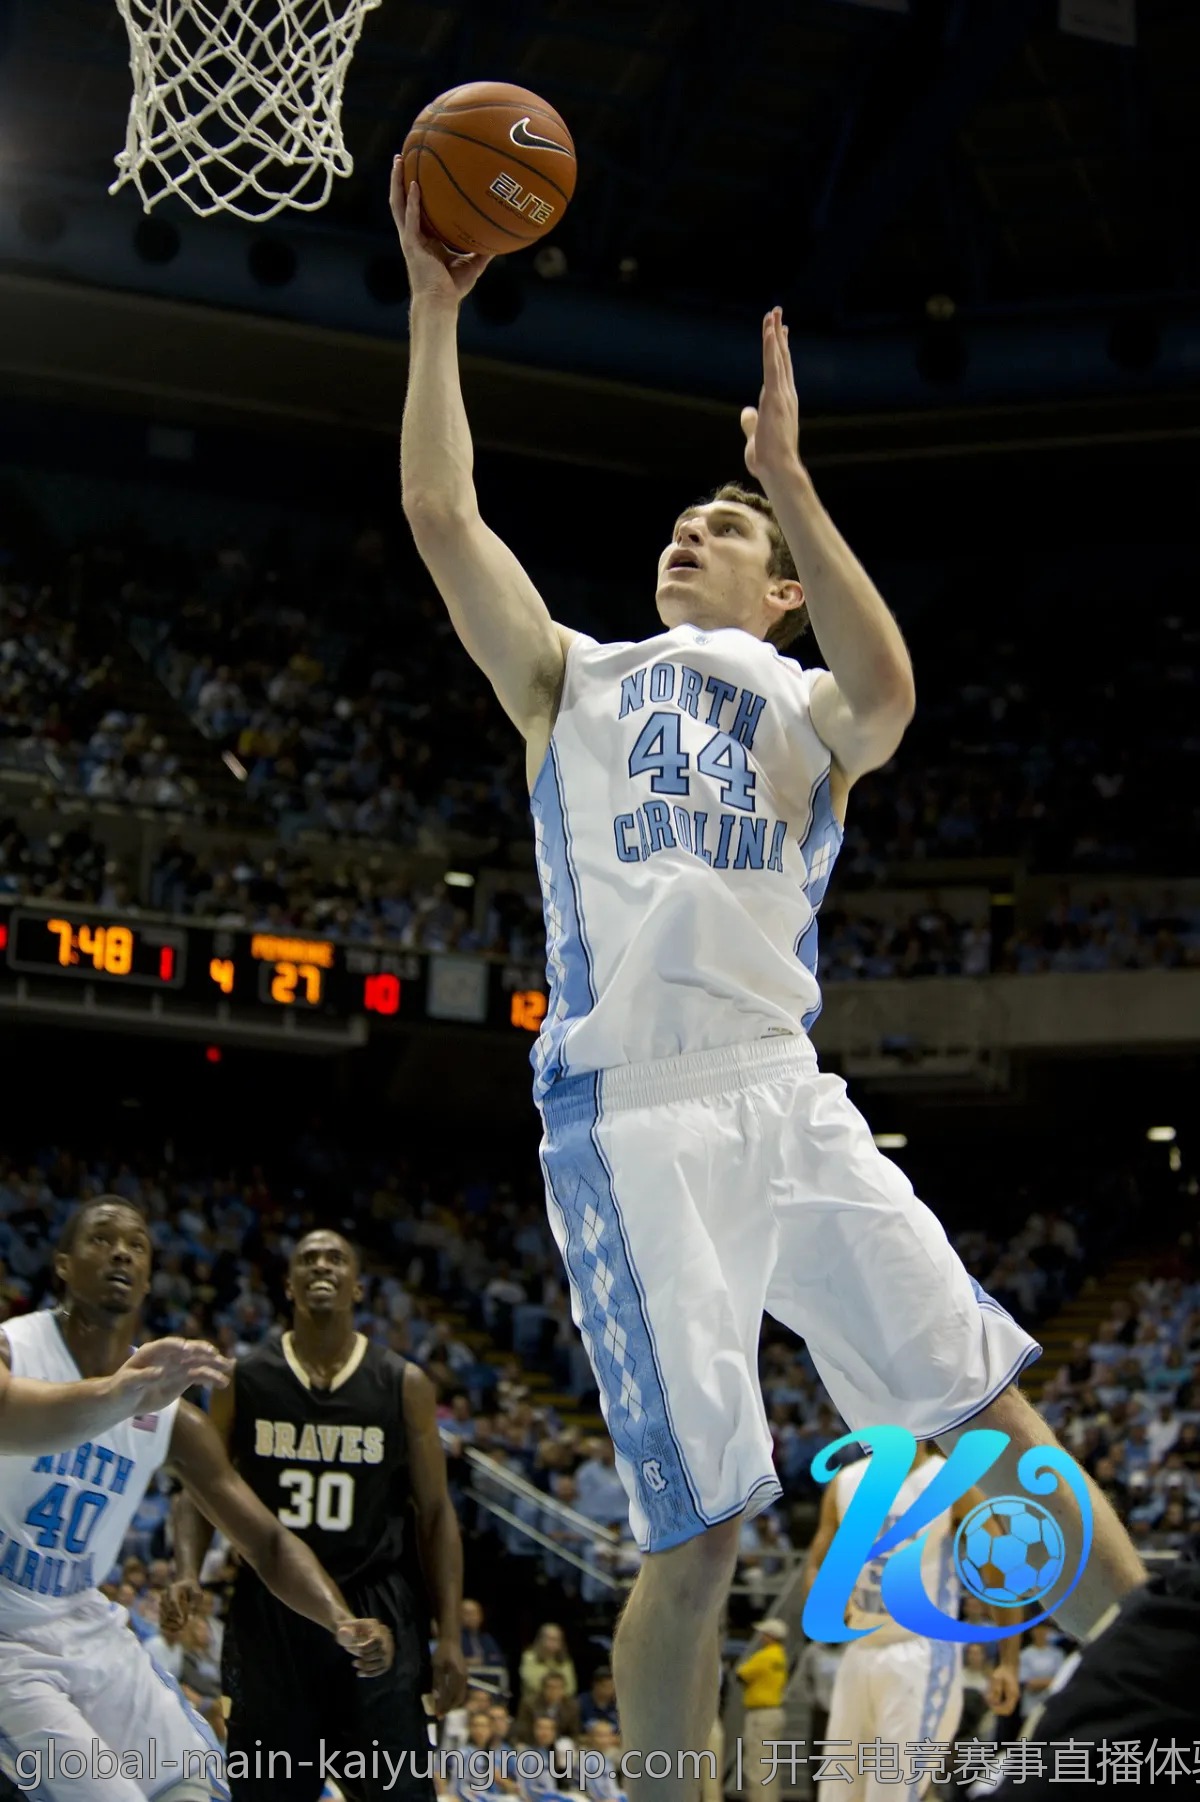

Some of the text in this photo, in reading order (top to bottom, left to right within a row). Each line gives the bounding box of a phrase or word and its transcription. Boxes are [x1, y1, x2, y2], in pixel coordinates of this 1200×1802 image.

[489, 171, 555, 225] ELITE
[617, 662, 768, 750] NORTH
[628, 711, 757, 813] 44
[613, 800, 788, 873] CAROLINA
[47, 918, 133, 976] 7:48
[209, 958, 235, 994] 4
[271, 961, 321, 1004] 27
[255, 1418, 385, 1465] BRAVES
[25, 1481, 109, 1555] 40
[278, 1469, 355, 1532] 30
